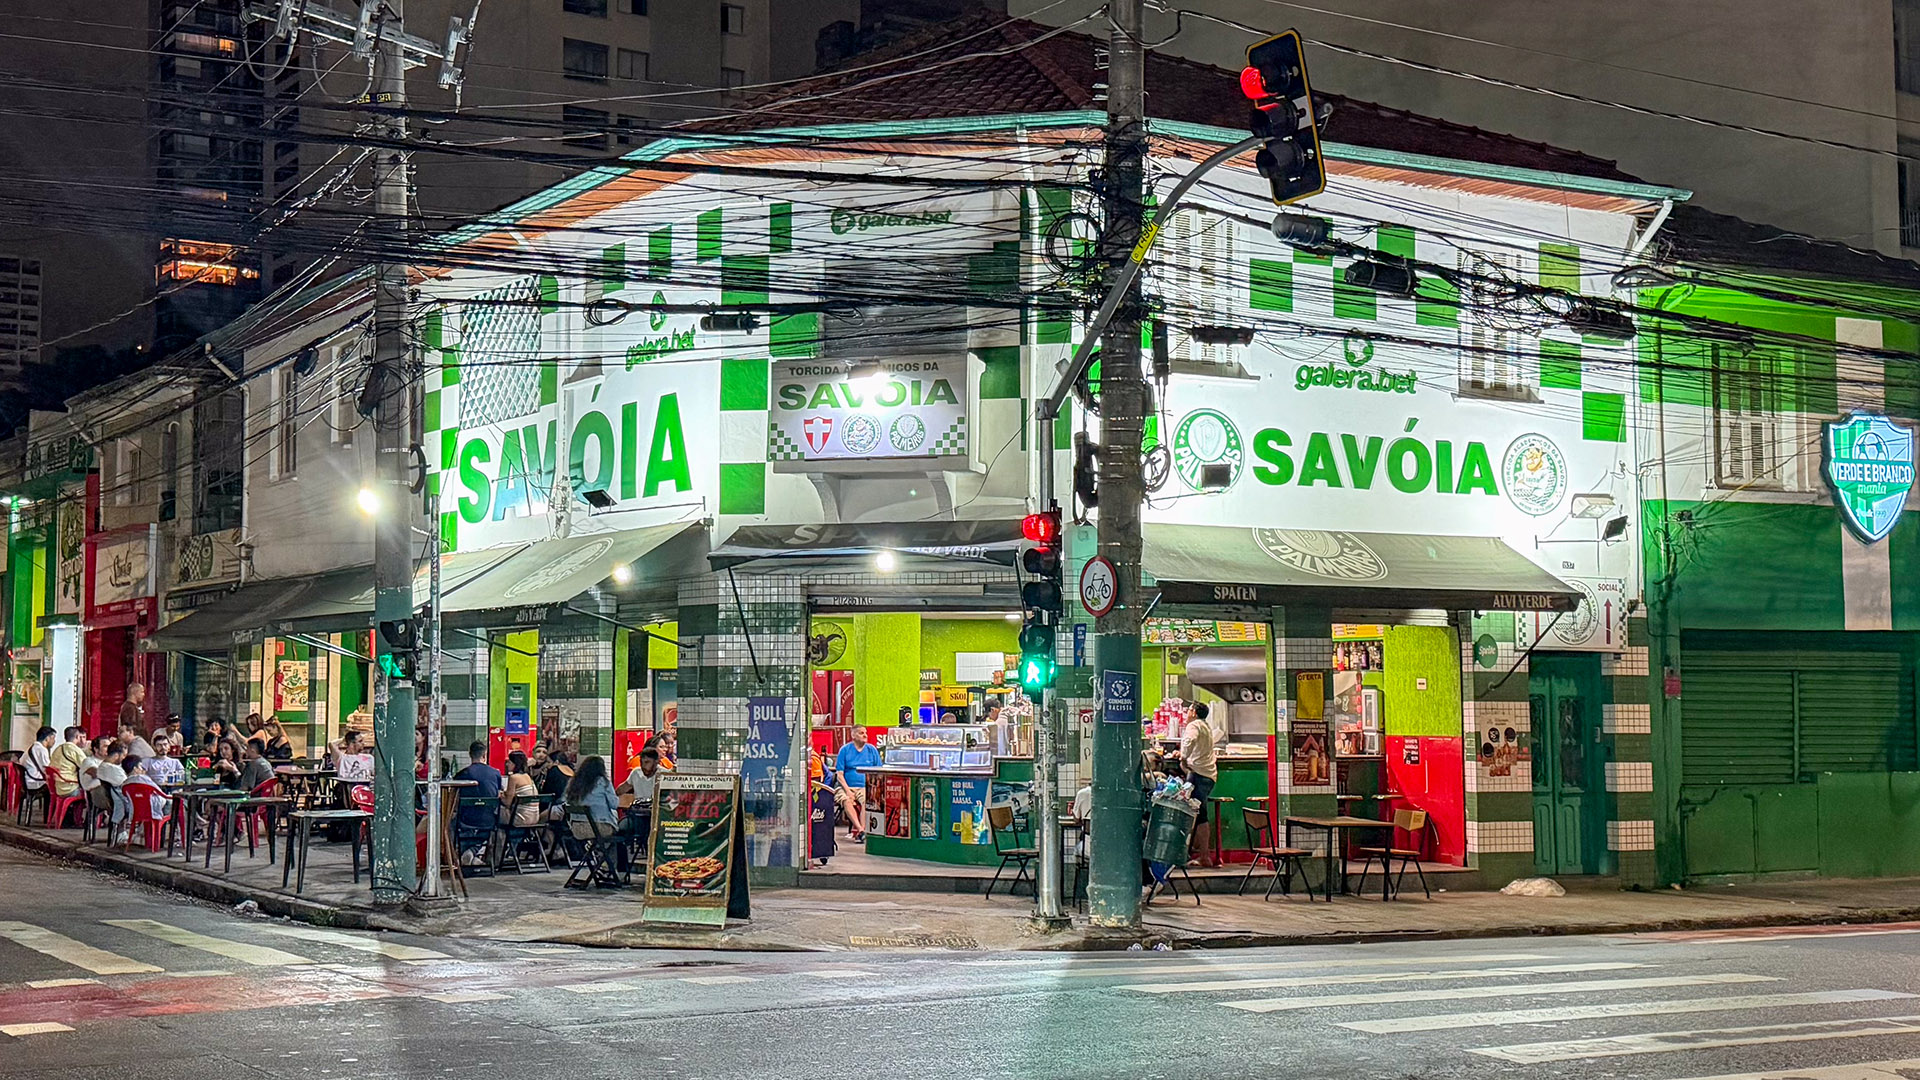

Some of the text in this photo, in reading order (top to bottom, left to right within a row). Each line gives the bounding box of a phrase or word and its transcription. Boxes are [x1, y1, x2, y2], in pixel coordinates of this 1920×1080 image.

[857, 209, 953, 232] galera.bet
[624, 324, 697, 372] galera.bet
[789, 366, 839, 376] TORCIDA
[923, 362, 939, 372] DA
[1294, 363, 1418, 395] galera.bet
[889, 428, 926, 451] PALMEIRAS
[457, 383, 693, 524] SAVÓIA
[1252, 417, 1500, 496] SAVÓIA
[1831, 462, 1912, 484] VERDE E BRANCO
[1268, 545, 1379, 578] PALMEIRAS
[1213, 586, 1257, 600] SPATEN
[1597, 583, 1618, 591] SOCIAL
[1493, 595, 1553, 609] ALVI VERDE
[1479, 645, 1496, 656] Sprite
[753, 706, 782, 721] BULL
[677, 791, 728, 804] MELHOR
[674, 804, 720, 819] PIZZA
